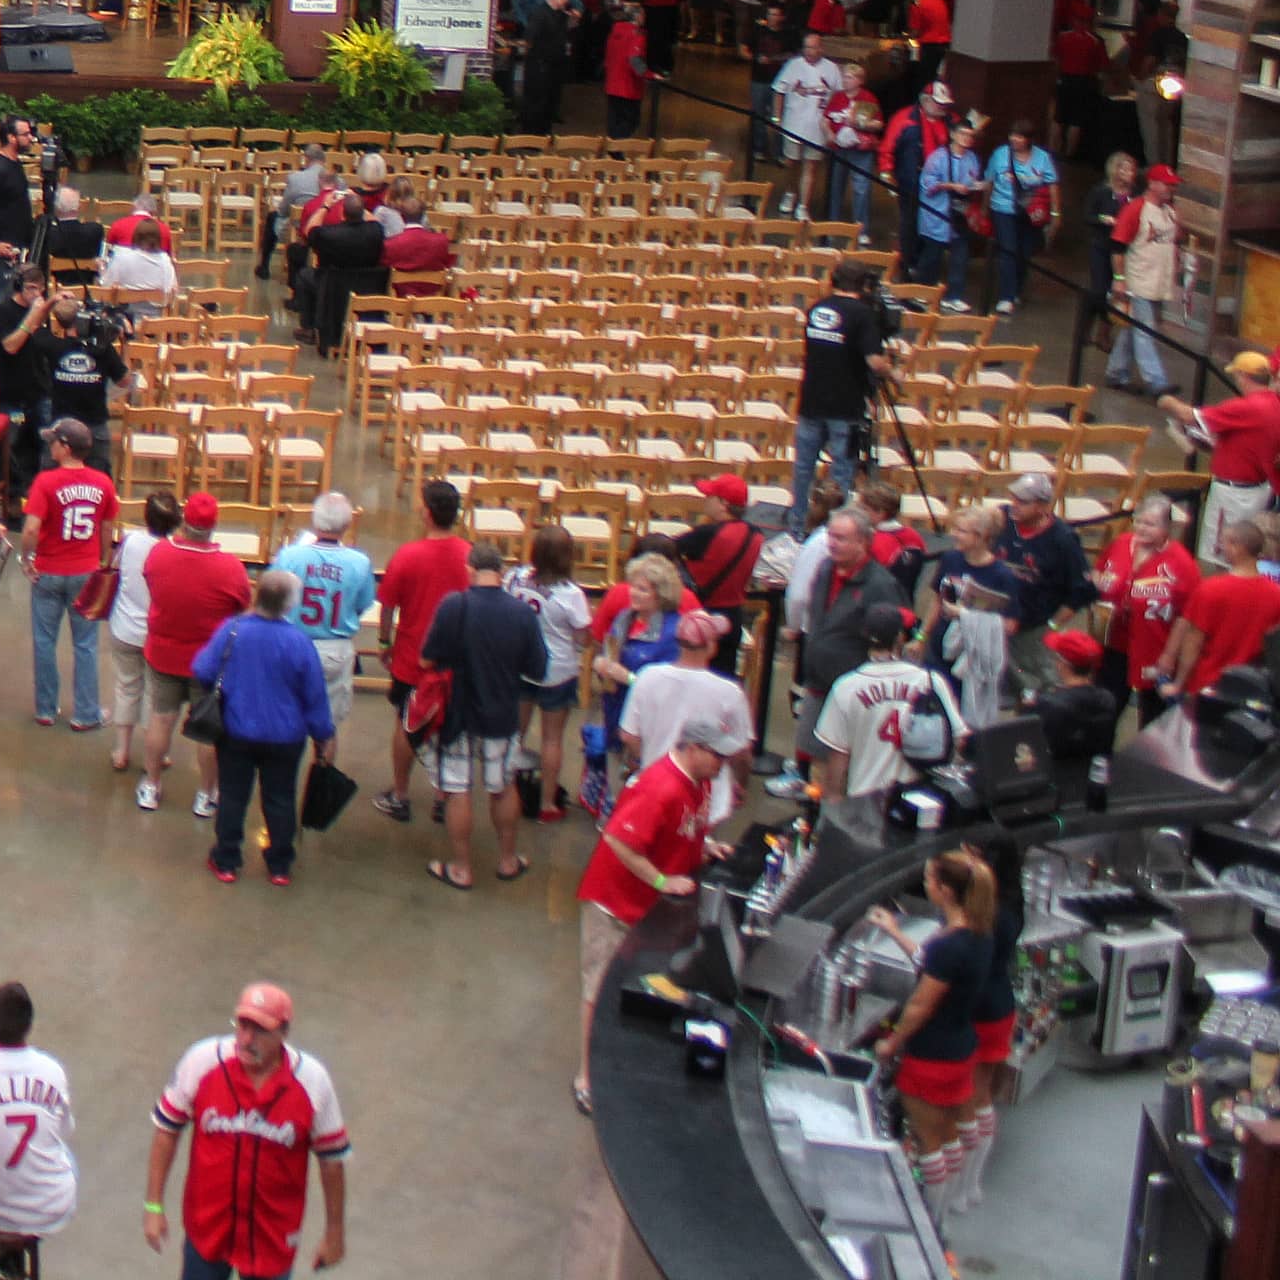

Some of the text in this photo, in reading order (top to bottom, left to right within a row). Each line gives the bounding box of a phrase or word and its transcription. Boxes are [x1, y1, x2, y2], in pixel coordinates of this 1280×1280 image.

[55, 371, 102, 383] MIDWEST
[56, 485, 104, 505] EDMONDS
[63, 506, 96, 541] 15
[306, 563, 343, 583] McGEE
[301, 587, 343, 628] 51
[877, 709, 903, 751] 4
[4, 1114, 37, 1170] 7
